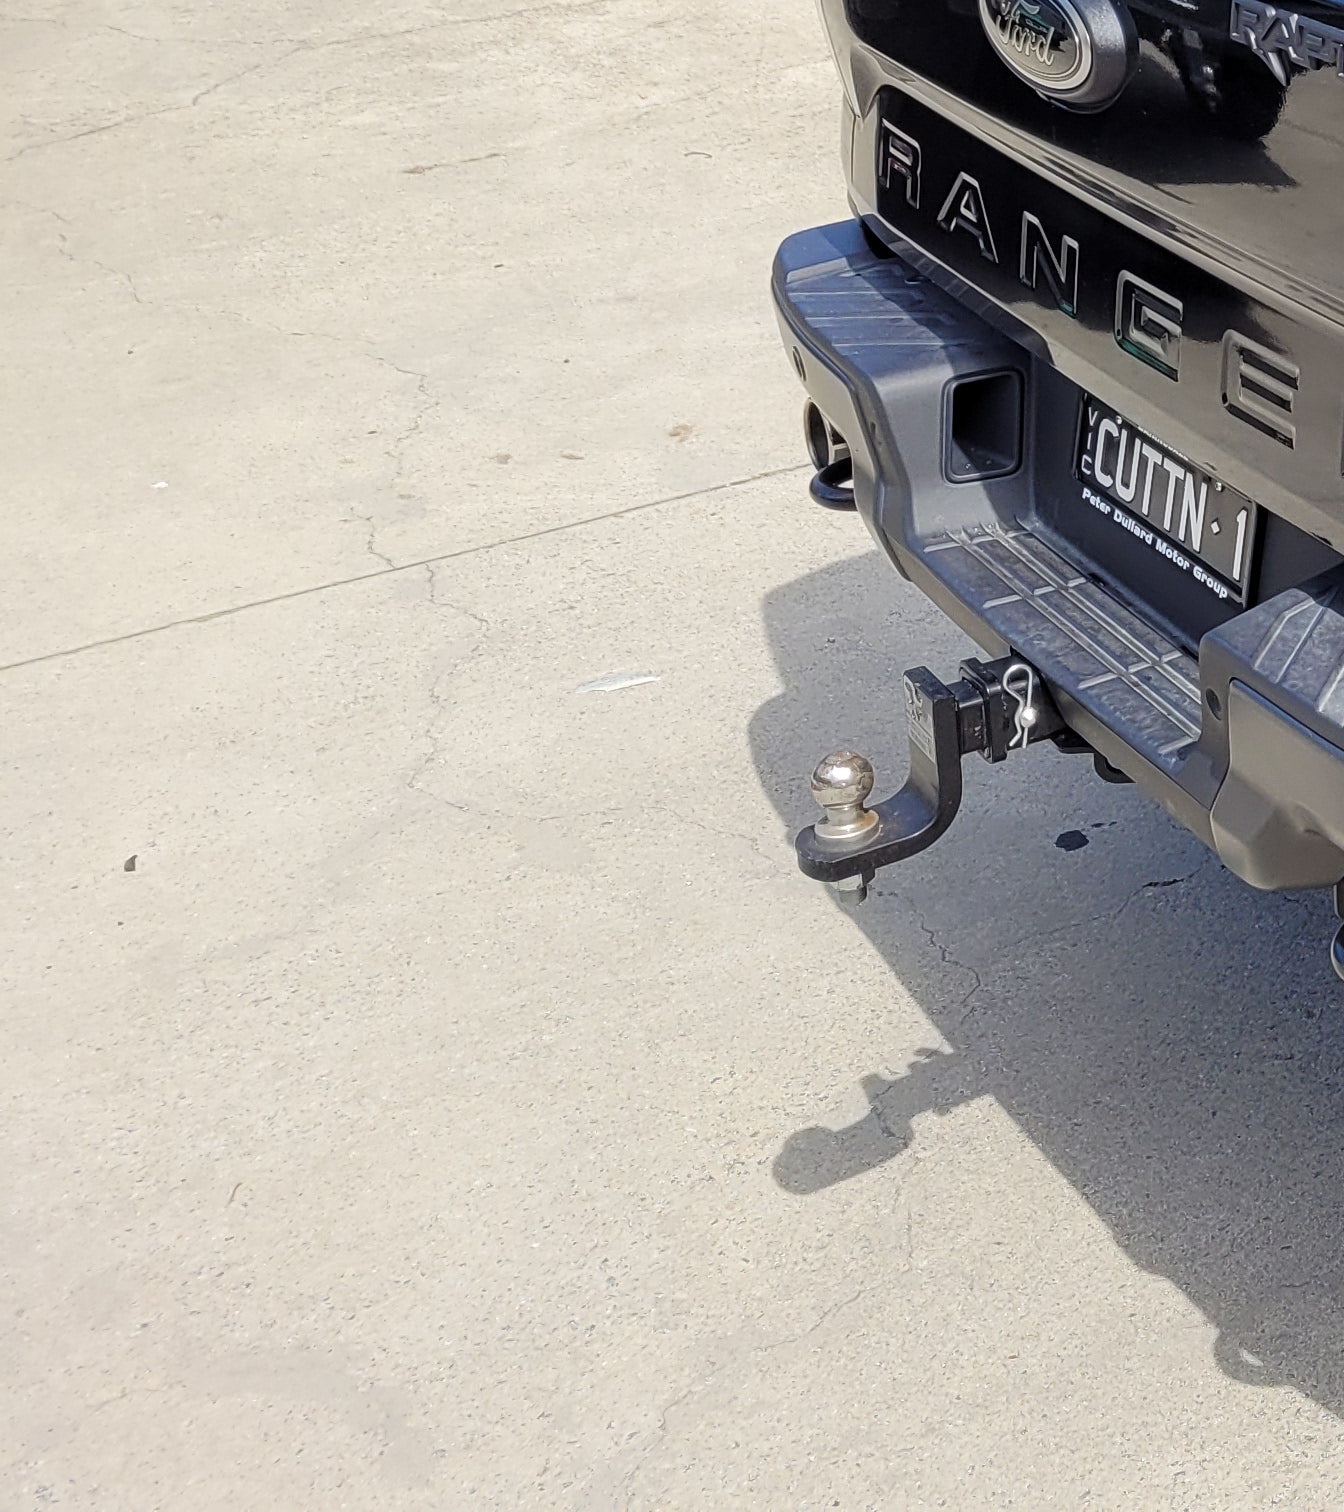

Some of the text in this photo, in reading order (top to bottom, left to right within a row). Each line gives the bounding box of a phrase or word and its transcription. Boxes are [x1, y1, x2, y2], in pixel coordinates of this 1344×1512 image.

[1081, 487, 1228, 599] Peter Dullard Motor Group
[1094, 418, 1208, 553] CUTTN
